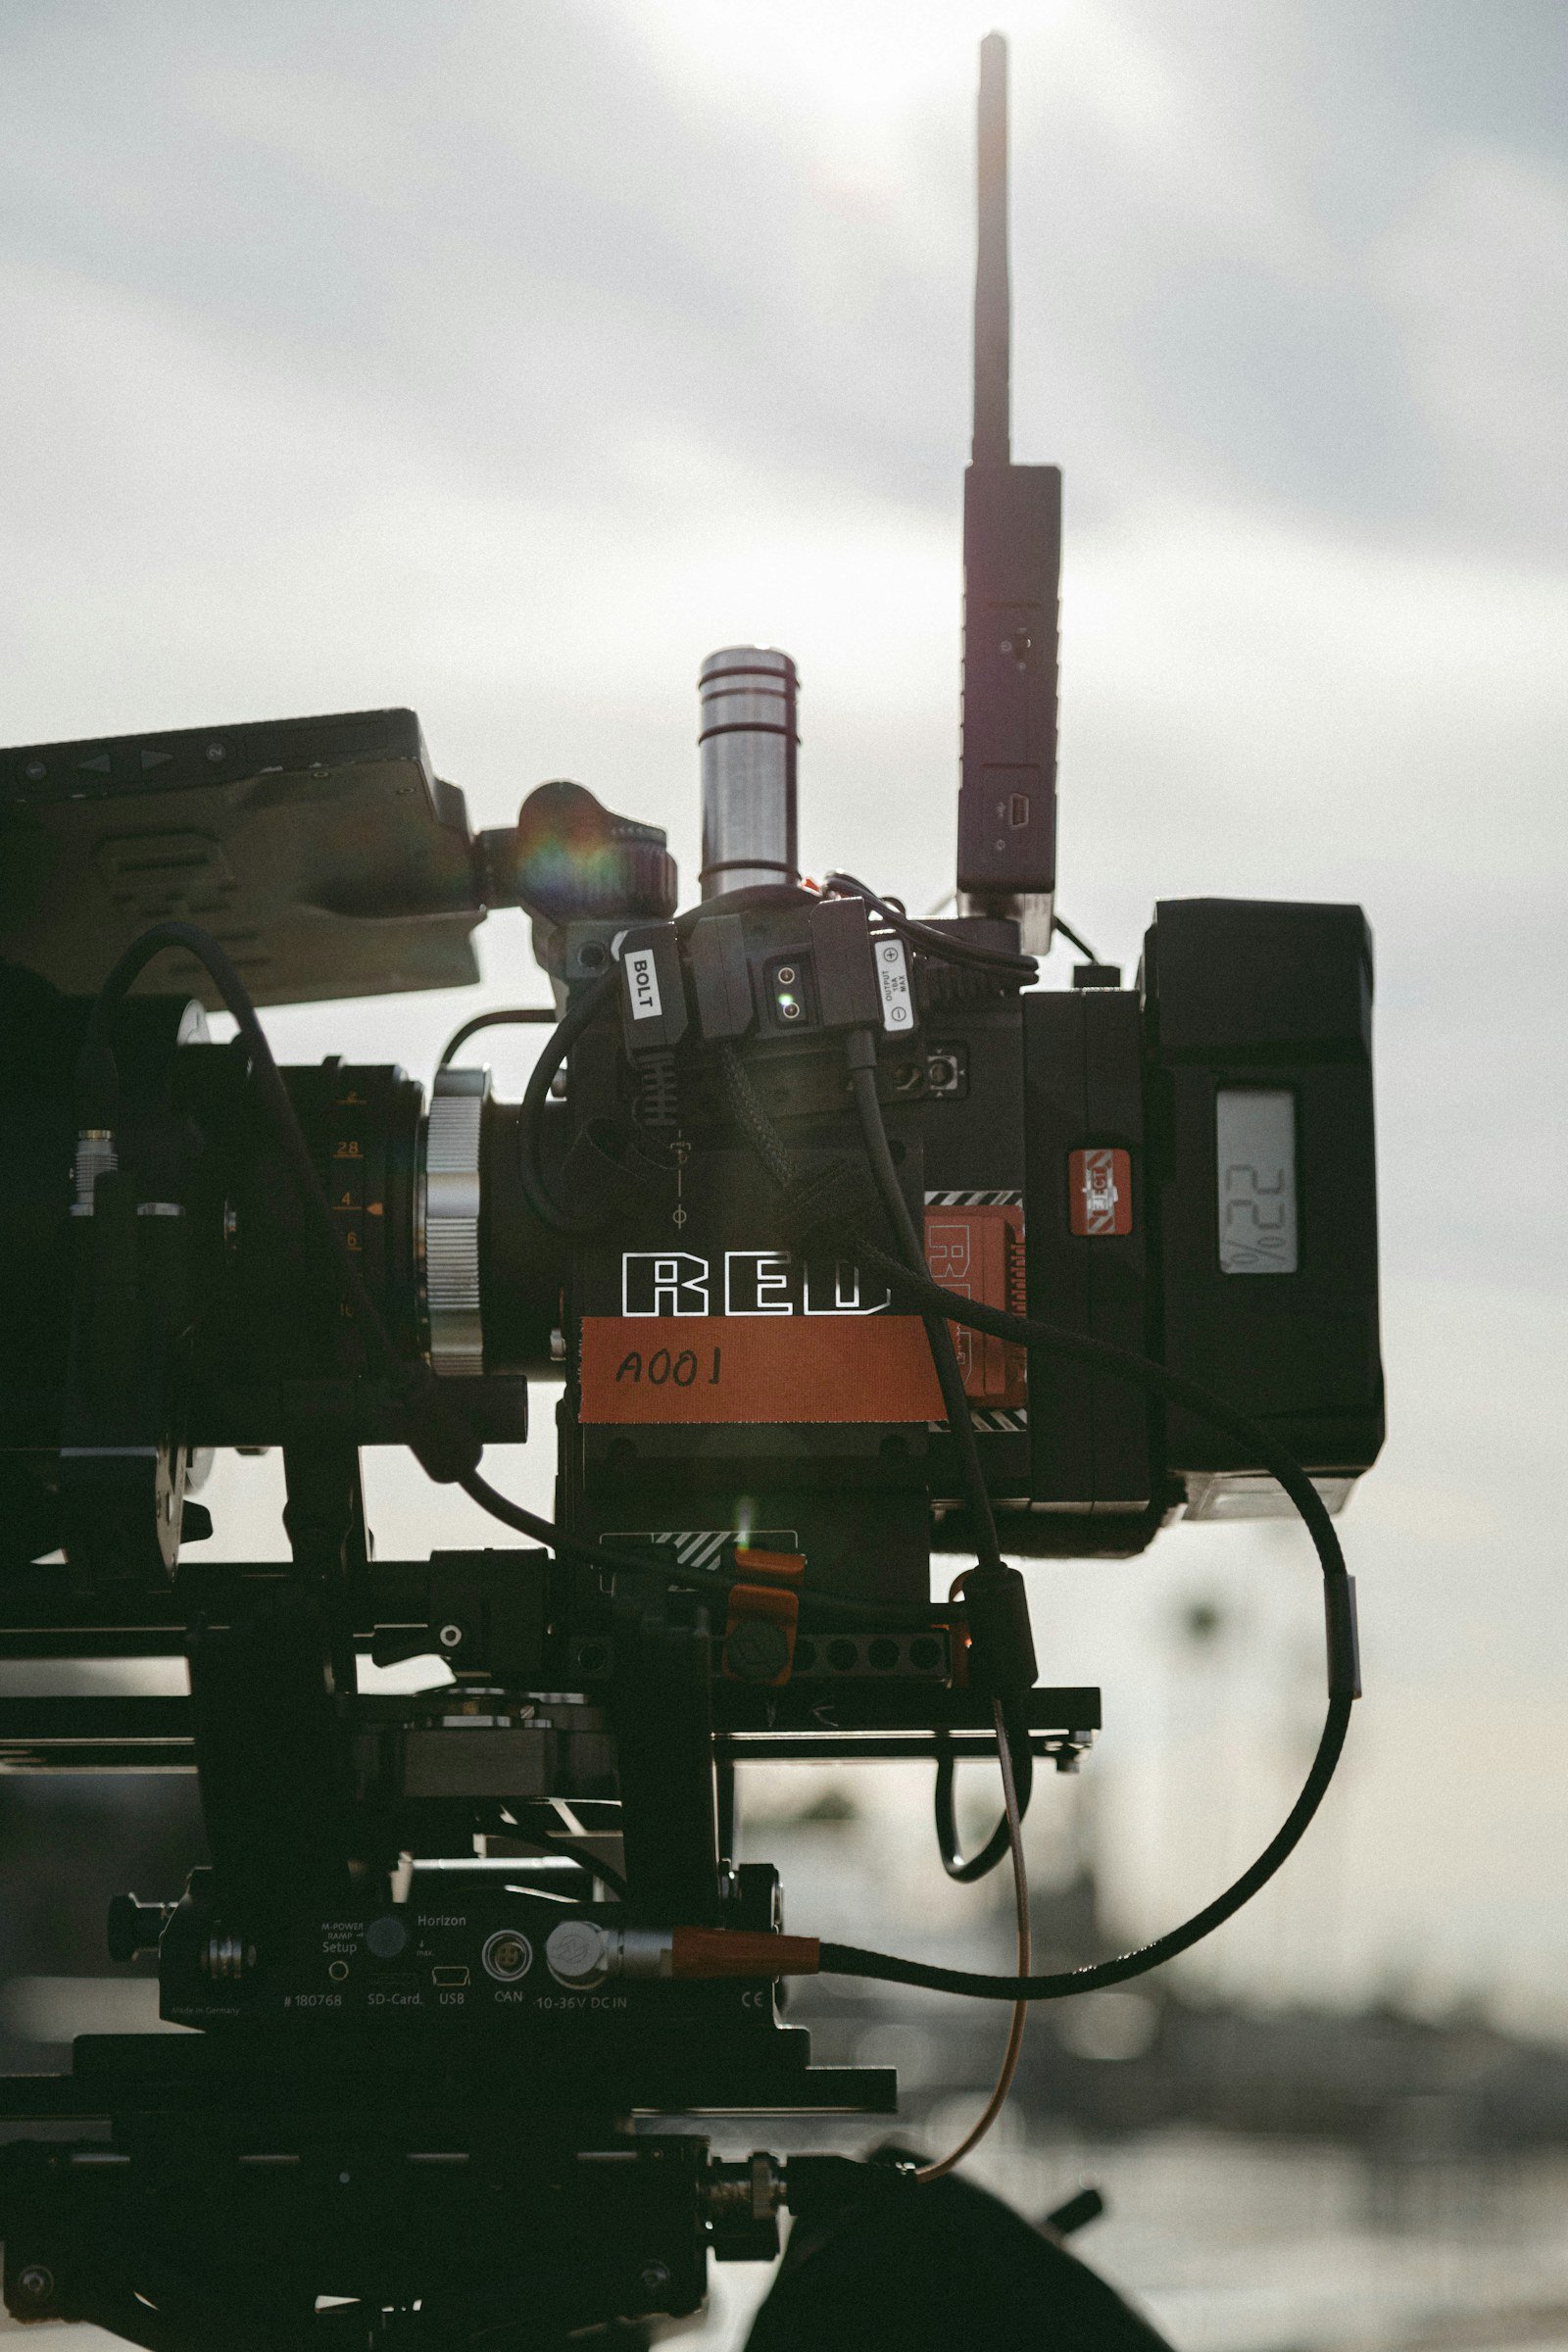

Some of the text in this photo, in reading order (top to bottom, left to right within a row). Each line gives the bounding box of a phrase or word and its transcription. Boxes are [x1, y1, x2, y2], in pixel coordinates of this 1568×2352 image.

[633, 958, 654, 1008] BOLT
[882, 970, 893, 1002] OUTPUT
[342, 1192, 351, 1206] 4
[347, 1231, 357, 1247] 6
[621, 1250, 892, 1317] RED
[615, 1347, 721, 1387] A001
[321, 1922, 364, 1931] M-POWER
[417, 1914, 466, 1928] Horizon
[327, 1932, 353, 1940] RAMP
[322, 1941, 358, 1955] Setup
[439, 1992, 465, 2005] USB
[495, 1990, 523, 2003] CAN
[536, 1996, 586, 2009] 10-36V
